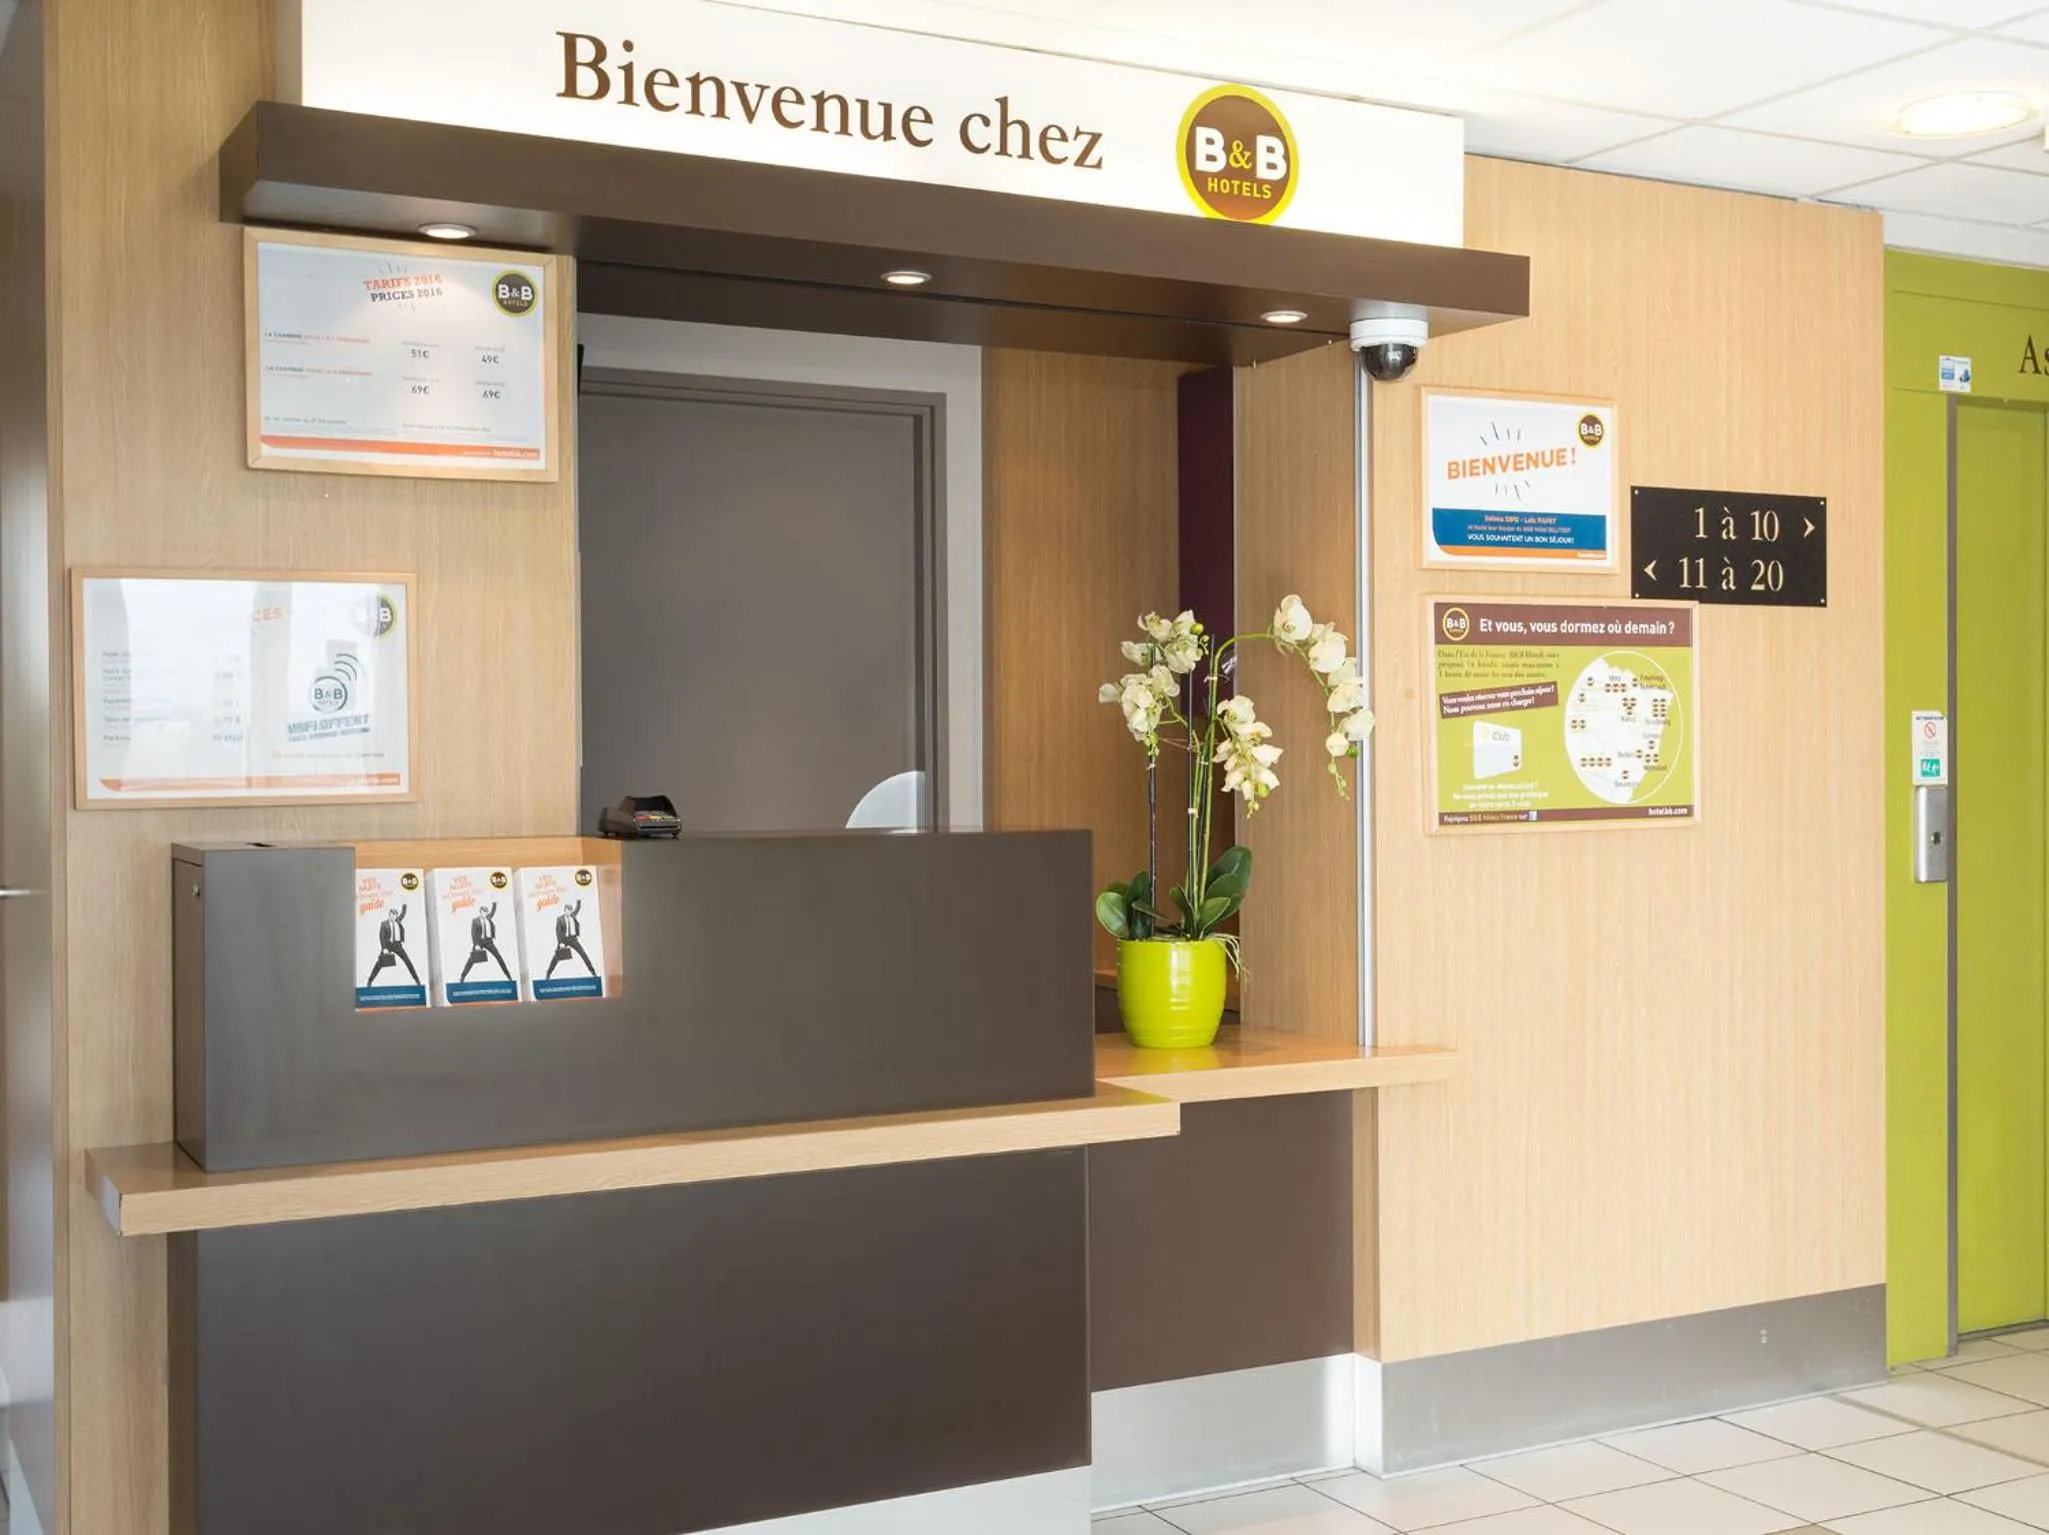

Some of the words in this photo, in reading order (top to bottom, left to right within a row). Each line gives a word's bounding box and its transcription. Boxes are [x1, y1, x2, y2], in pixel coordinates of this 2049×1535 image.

[556, 32, 933, 148] Bienvenue
[959, 95, 1104, 170] chez
[1196, 126, 1287, 181] B&B
[1207, 177, 1272, 199] HOTELS
[363, 276, 411, 290] TARIFS
[370, 290, 415, 302] PRICES
[415, 287, 443, 298] 2016
[498, 283, 533, 301] B&B
[481, 354, 500, 365] 49€
[411, 385, 430, 395] 69€
[1581, 423, 1602, 437] B&B
[1694, 507, 1708, 539] 1
[1721, 506, 1737, 540] à
[1750, 510, 1779, 542] 10
[1486, 534, 1524, 542] SOUHAITENT
[1535, 535, 1548, 543] BON
[1679, 556, 1708, 589] 11
[1721, 556, 1736, 590] à
[1750, 559, 1784, 592] 20
[1446, 617, 1466, 629] B&B
[1479, 618, 1494, 632] Et
[1495, 621, 1527, 635] vous,
[1529, 621, 1557, 633] vous
[1559, 620, 1606, 634] dormez
[1607, 620, 1623, 634] où
[314, 688, 343, 701] B&B
